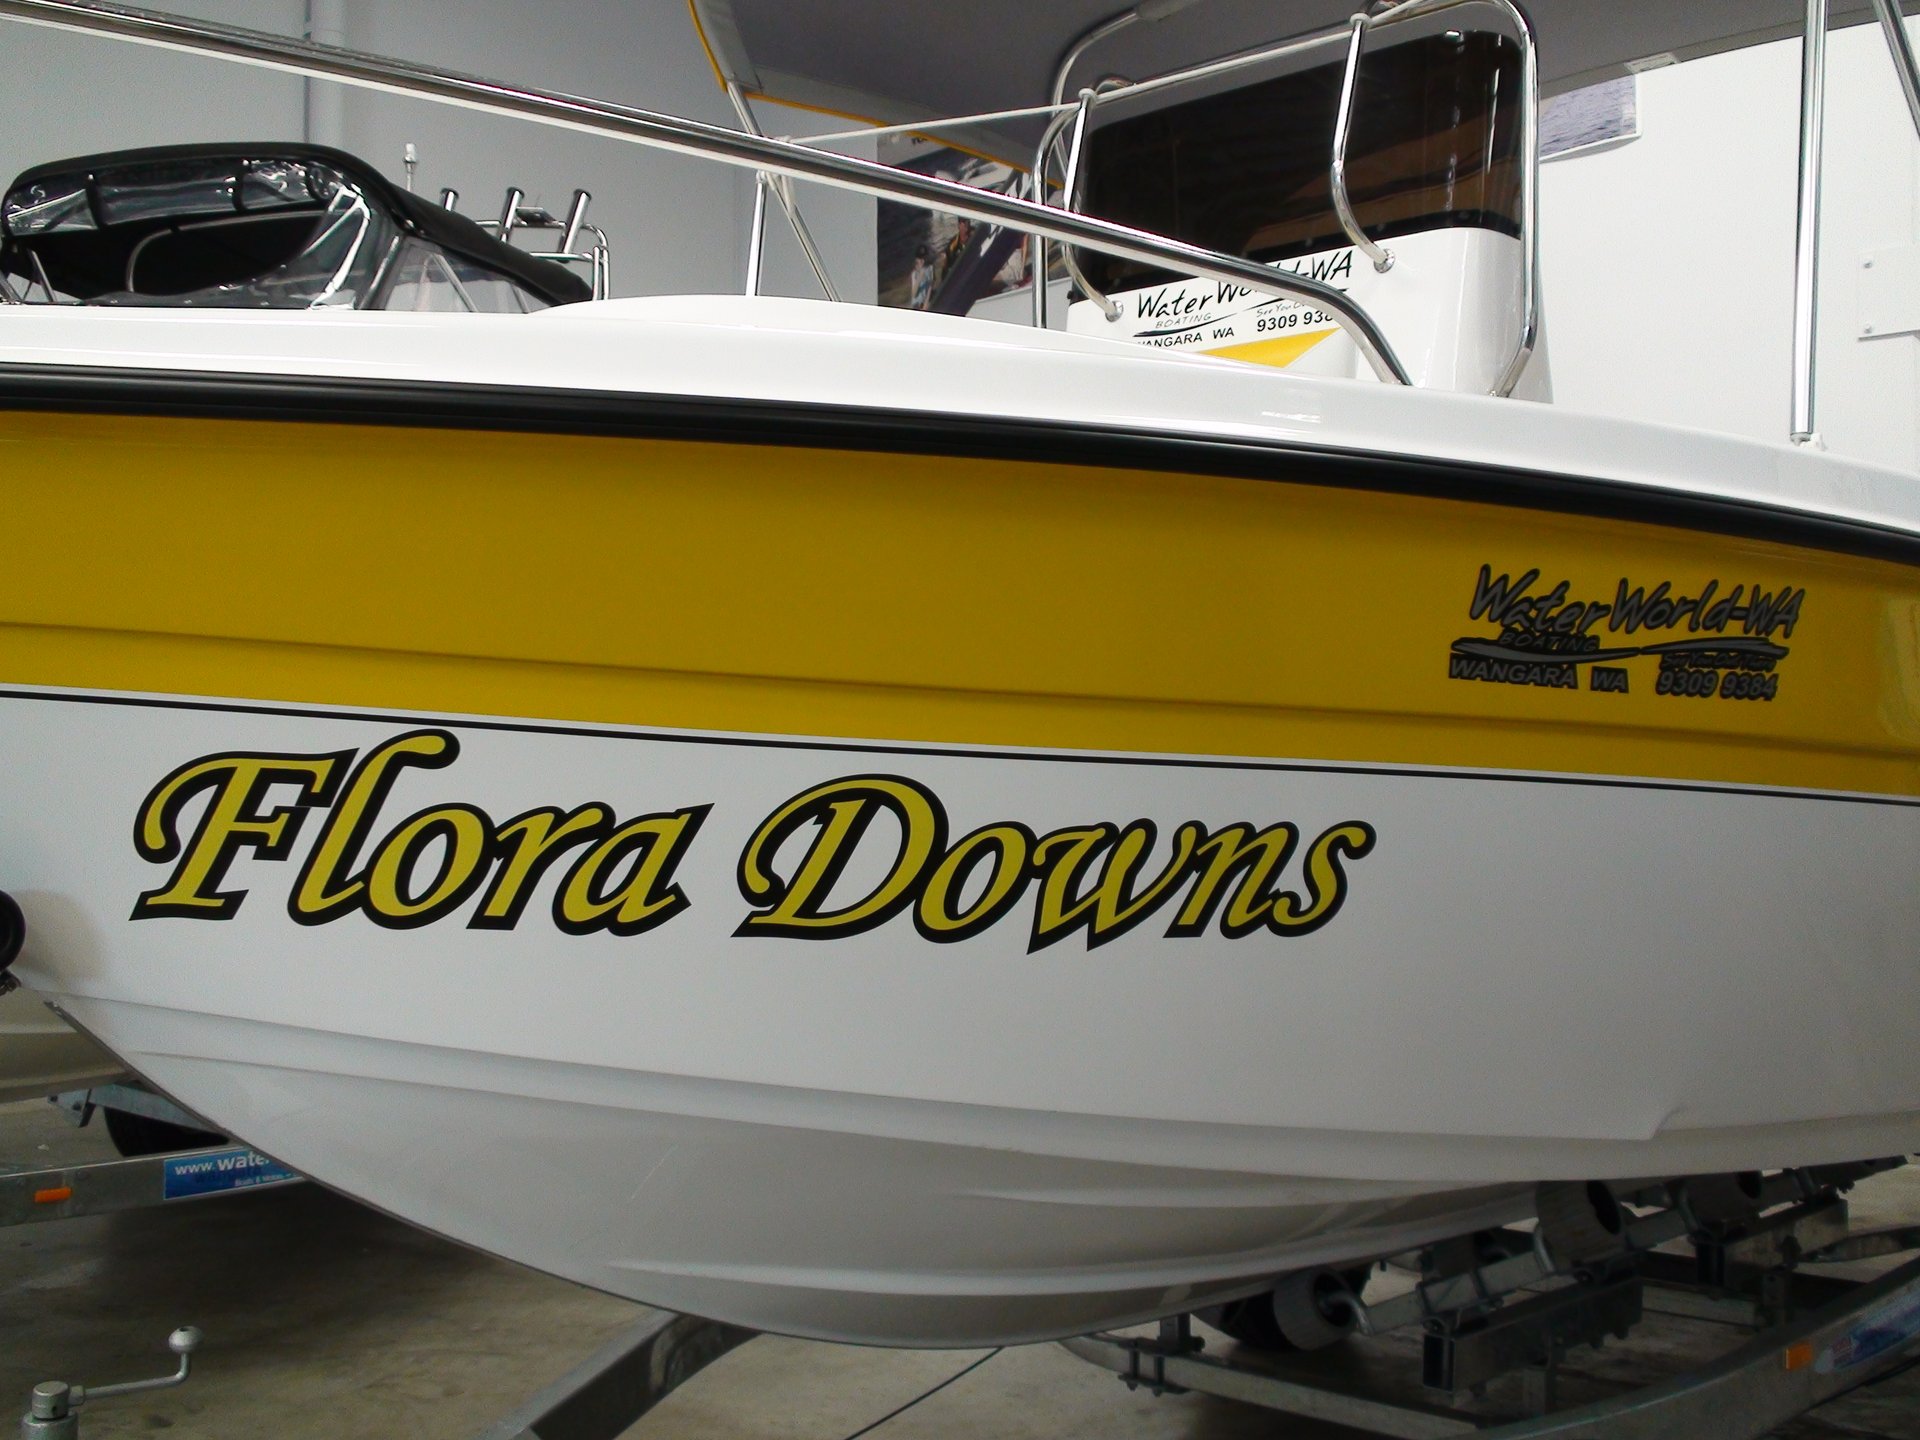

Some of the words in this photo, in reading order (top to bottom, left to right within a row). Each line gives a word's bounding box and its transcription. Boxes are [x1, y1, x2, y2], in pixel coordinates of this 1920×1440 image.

[1155, 312, 1212, 329] BOATING
[1257, 313, 1298, 332] 9309
[1212, 327, 1235, 339] WA
[1498, 630, 1600, 653] BOATING
[1450, 655, 1577, 688] WANGARA
[1591, 666, 1628, 693] WA
[1656, 671, 1718, 697] 9309
[1720, 672, 1777, 701] 9384
[129, 728, 715, 937] Flora
[730, 773, 1377, 954] Downs
